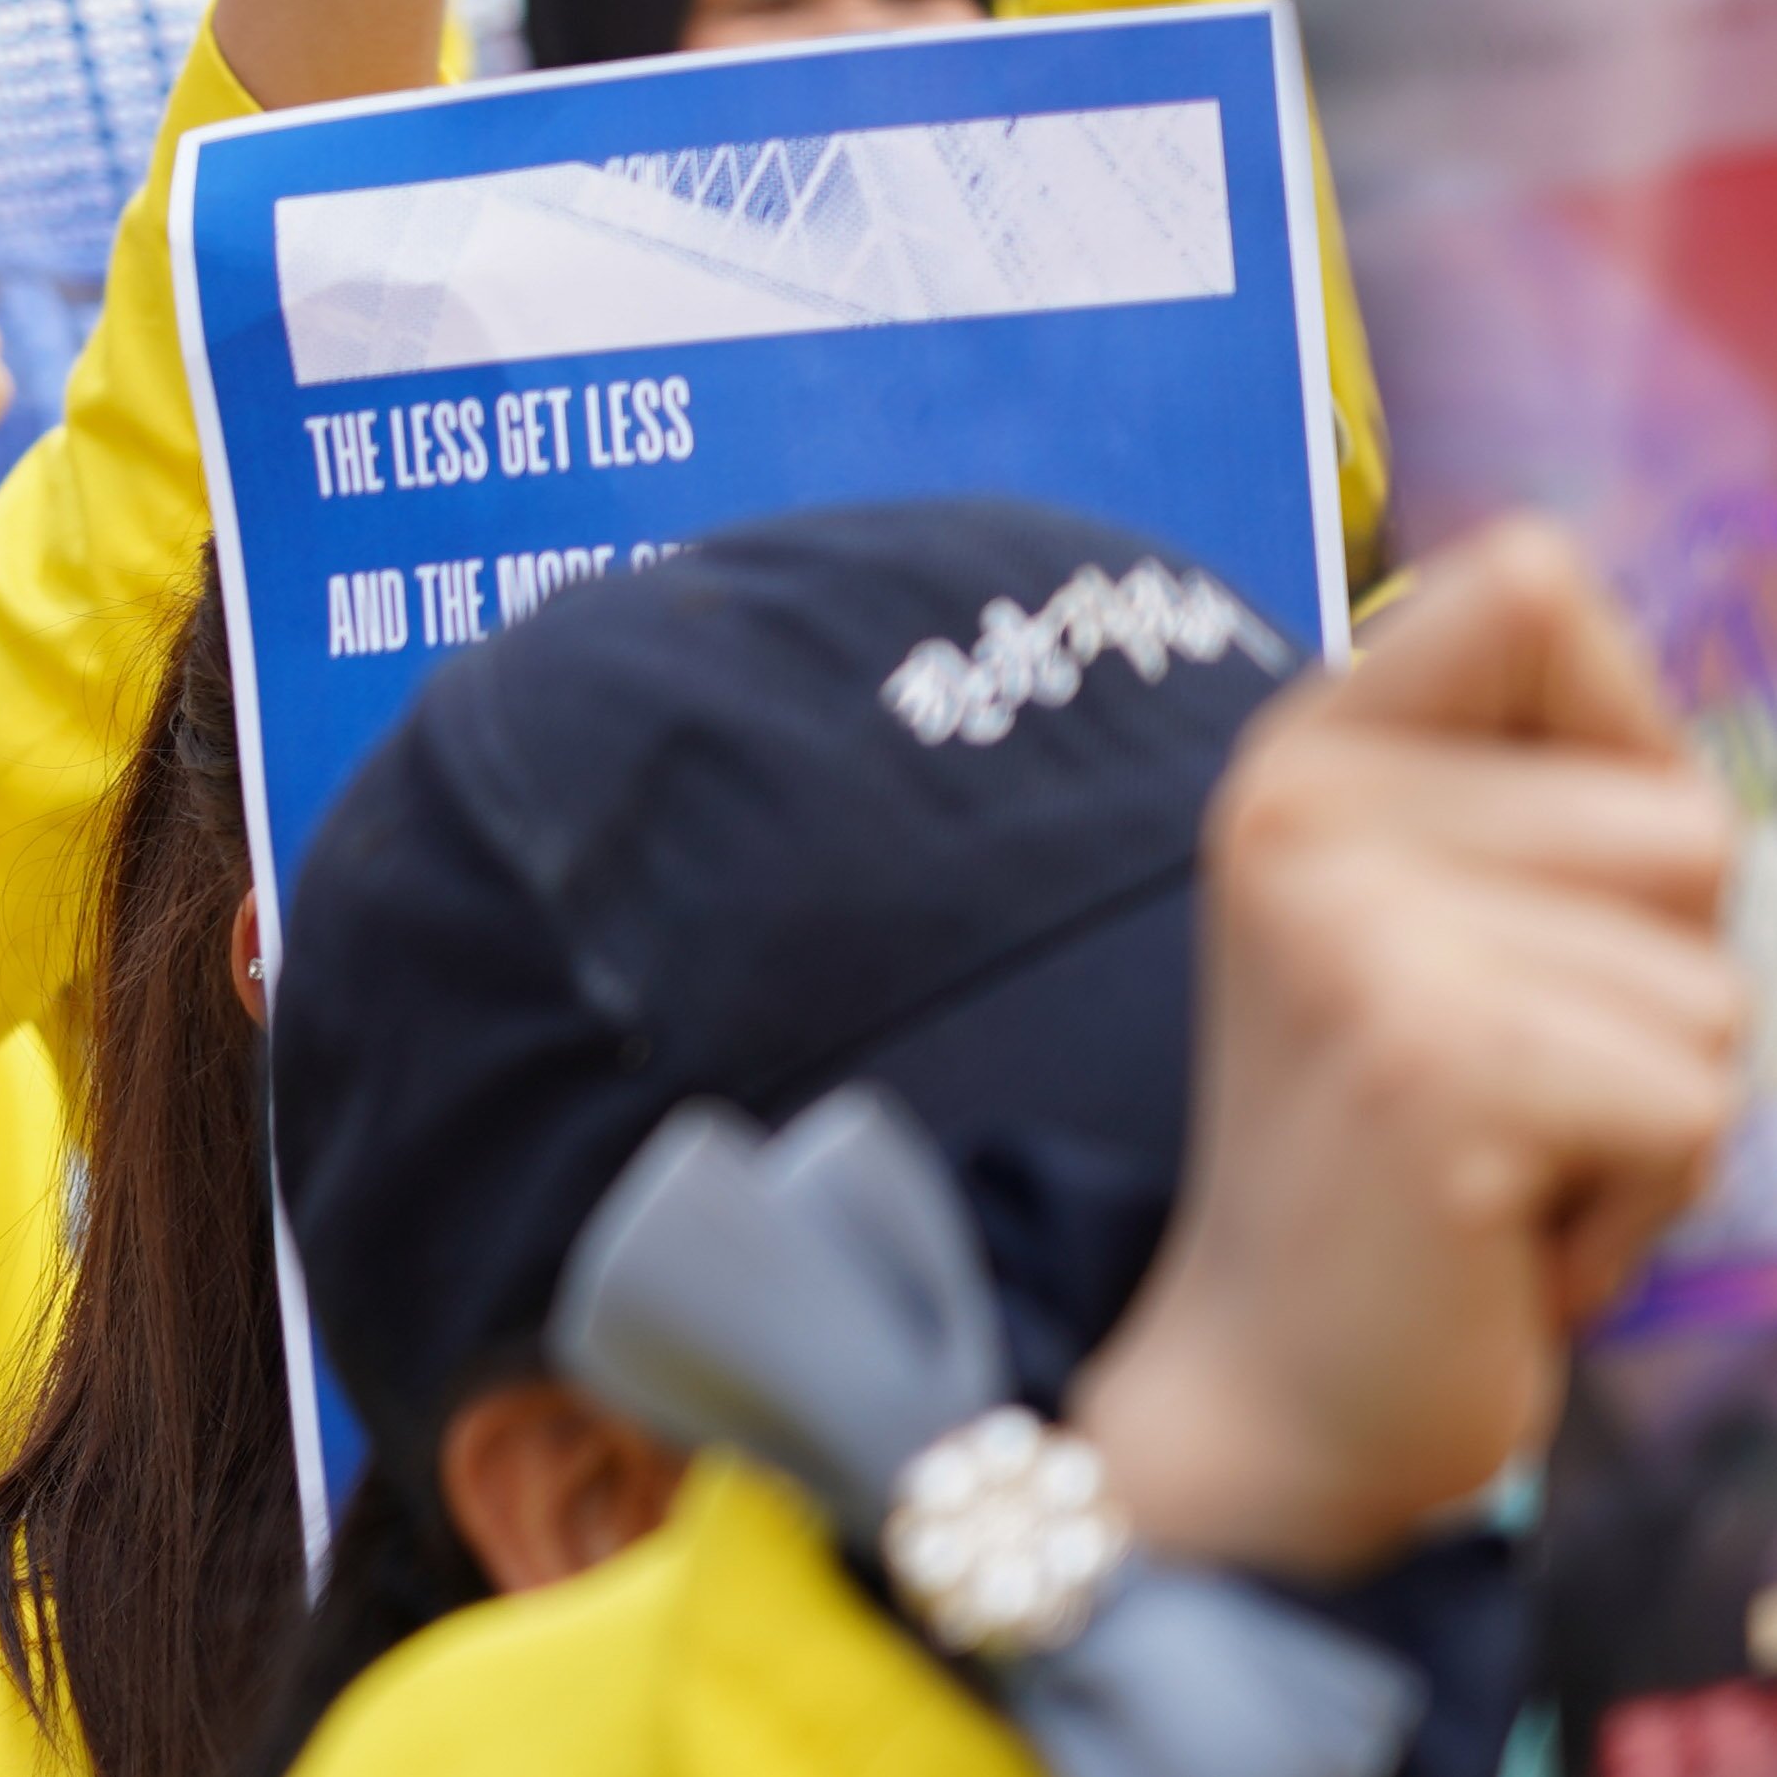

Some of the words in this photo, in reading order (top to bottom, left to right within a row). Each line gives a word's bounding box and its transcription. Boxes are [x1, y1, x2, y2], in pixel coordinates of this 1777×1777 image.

[303, 409, 386, 499] THE
[388, 396, 490, 491] LESS
[494, 386, 573, 479] GET
[583, 375, 695, 470] LESS
[327, 566, 409, 659] AND
[413, 557, 489, 649] THE
